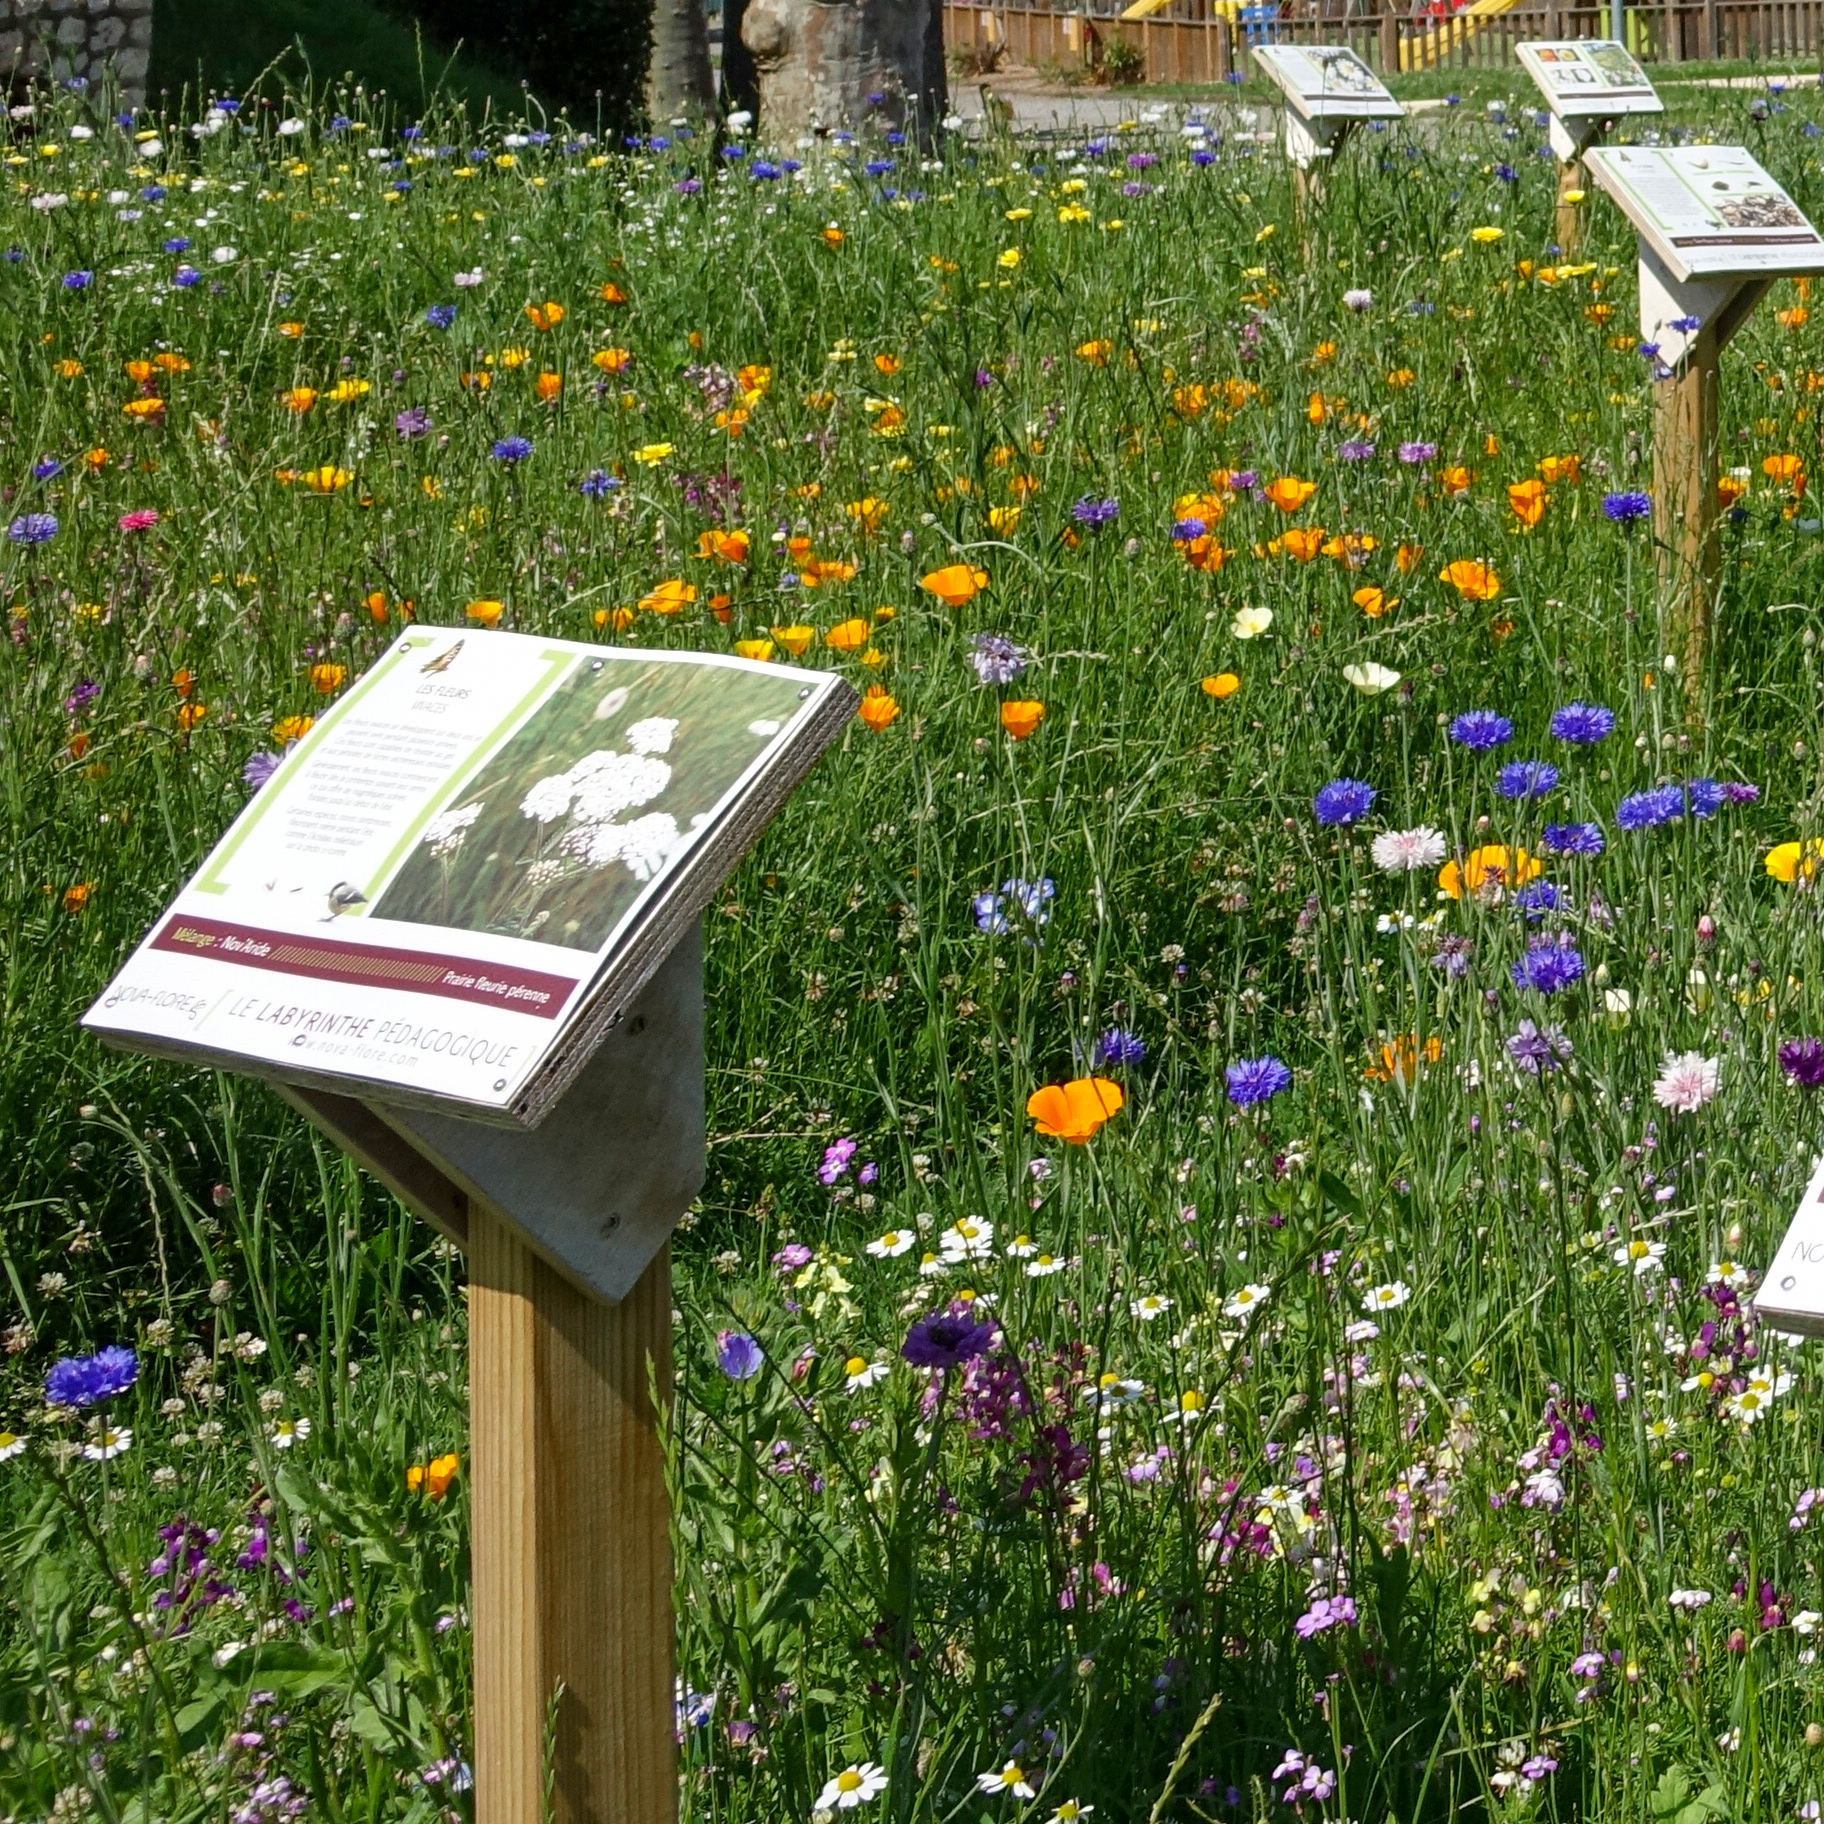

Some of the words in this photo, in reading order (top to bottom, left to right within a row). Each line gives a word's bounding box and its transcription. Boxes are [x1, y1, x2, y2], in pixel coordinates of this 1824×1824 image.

[171, 926, 216, 948] Mélange
[442, 970, 475, 989] Prairie
[474, 975, 508, 995] fleurie
[506, 983, 551, 1004] pérenne
[228, 996, 257, 1017] LE
[256, 1001, 376, 1039] LABYRINTHE
[373, 1017, 519, 1069] PÉDAGOGIQUE
[288, 1037, 418, 1067] w.nova-flore.com
